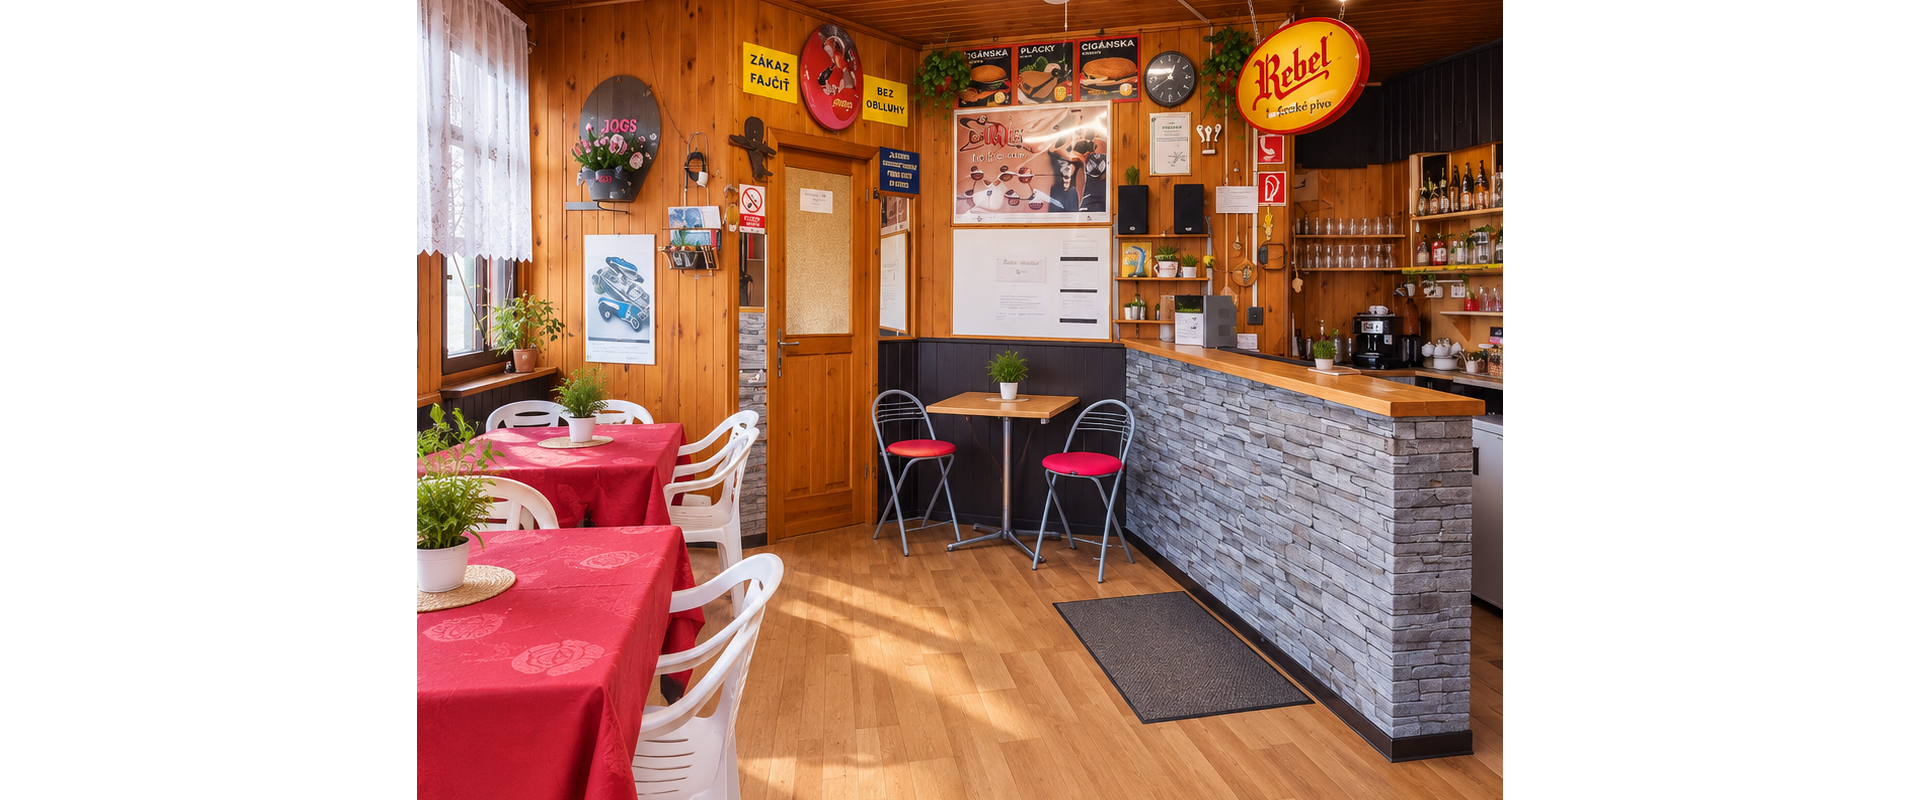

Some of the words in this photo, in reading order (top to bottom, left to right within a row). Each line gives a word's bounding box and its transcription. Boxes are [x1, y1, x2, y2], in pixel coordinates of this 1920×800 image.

[964, 48, 1009, 60] IGÁNSKA
[1020, 44, 1056, 55] PLACKY
[750, 53, 790, 74] ZÁKAZ
[1252, 34, 1332, 111] Rebel
[877, 86, 894, 98] BEZ
[1309, 99, 1332, 115] pivo
[604, 118, 637, 134] JOGS
